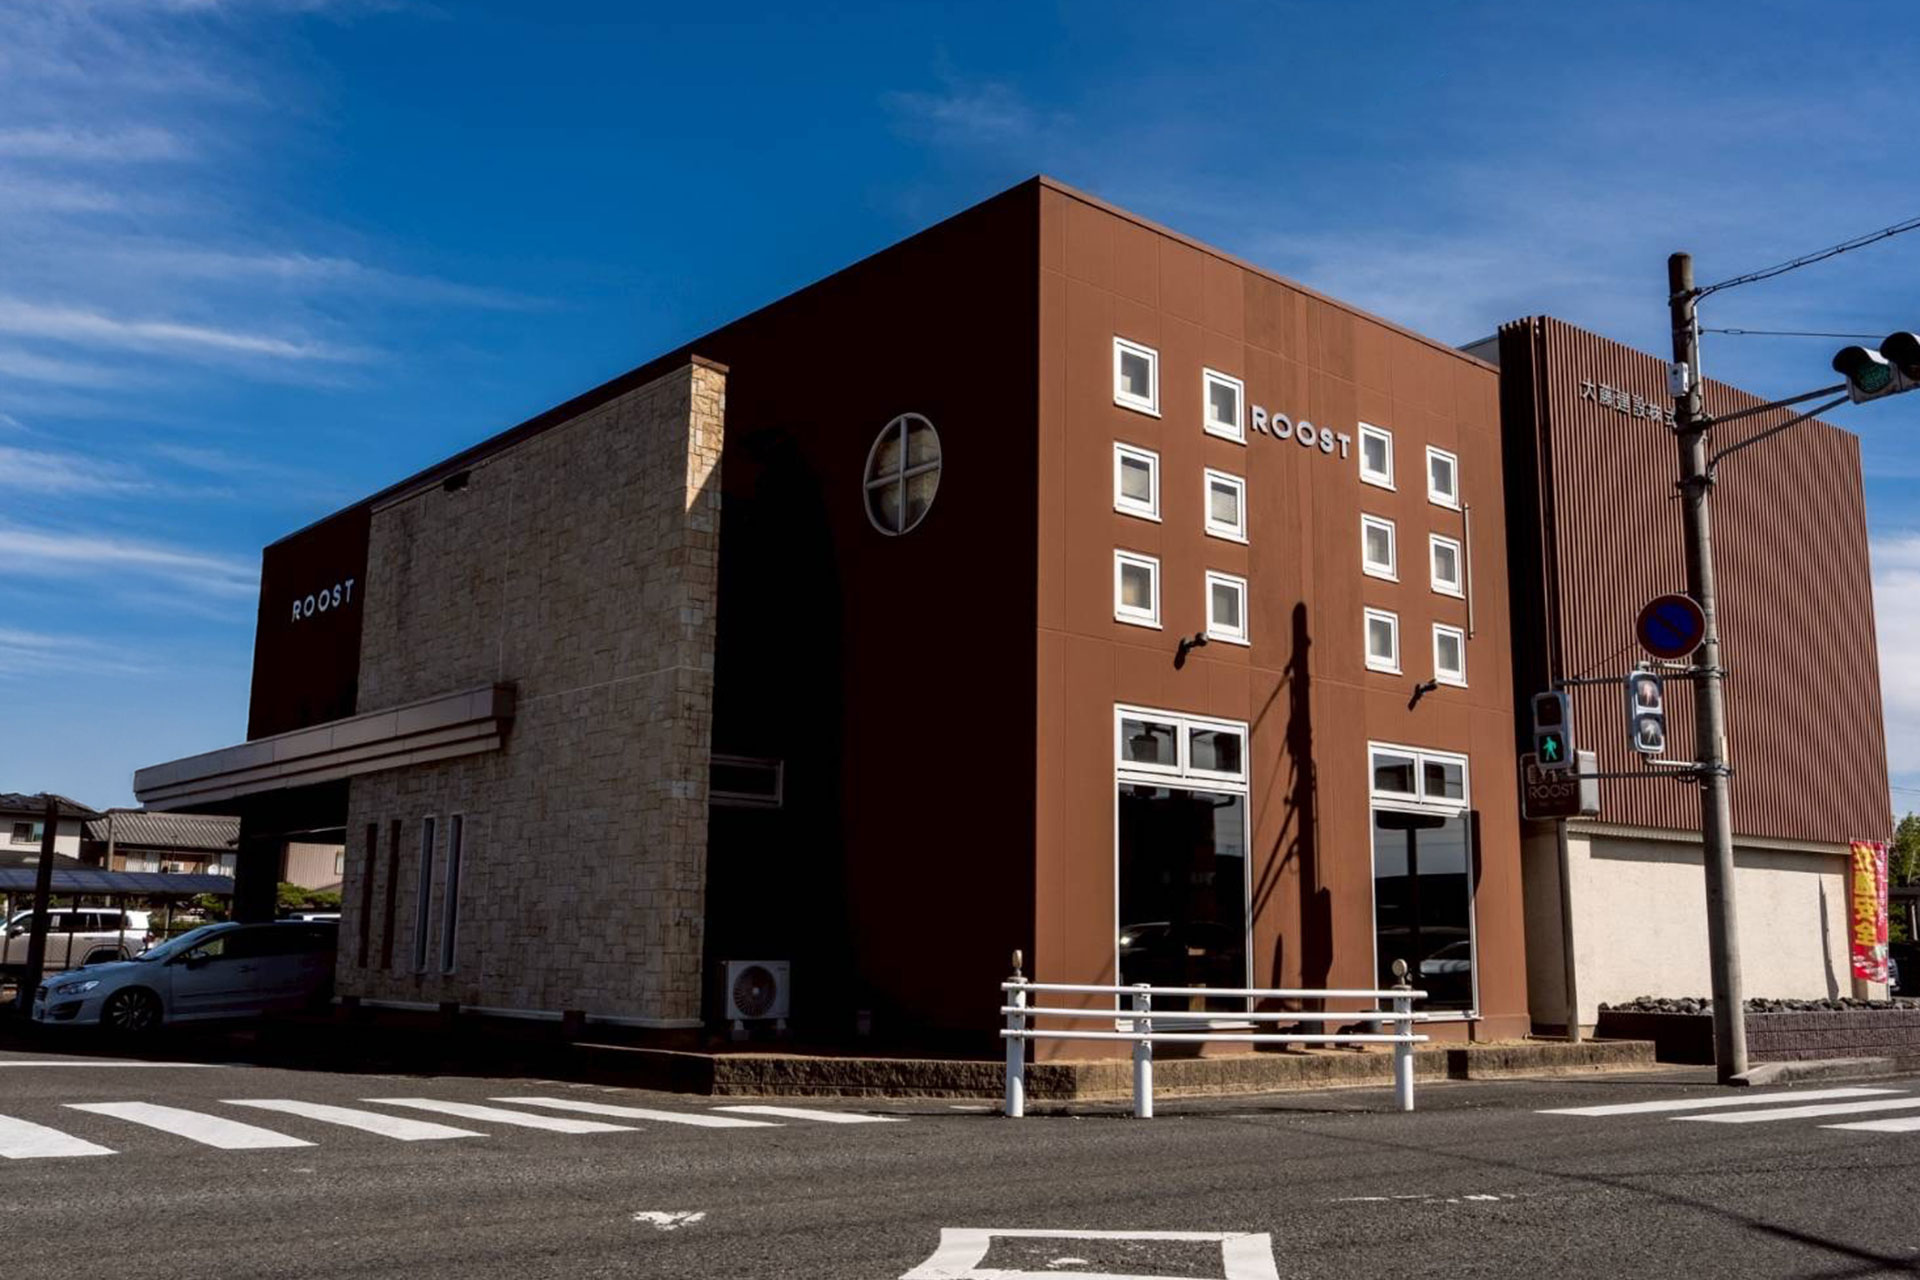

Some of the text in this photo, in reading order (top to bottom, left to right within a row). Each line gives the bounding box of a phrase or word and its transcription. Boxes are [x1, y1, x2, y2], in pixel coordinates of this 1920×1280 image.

[1250, 404, 1351, 459] ROOST
[291, 578, 355, 623] ROOST
[1528, 783, 1576, 799] ROOST
